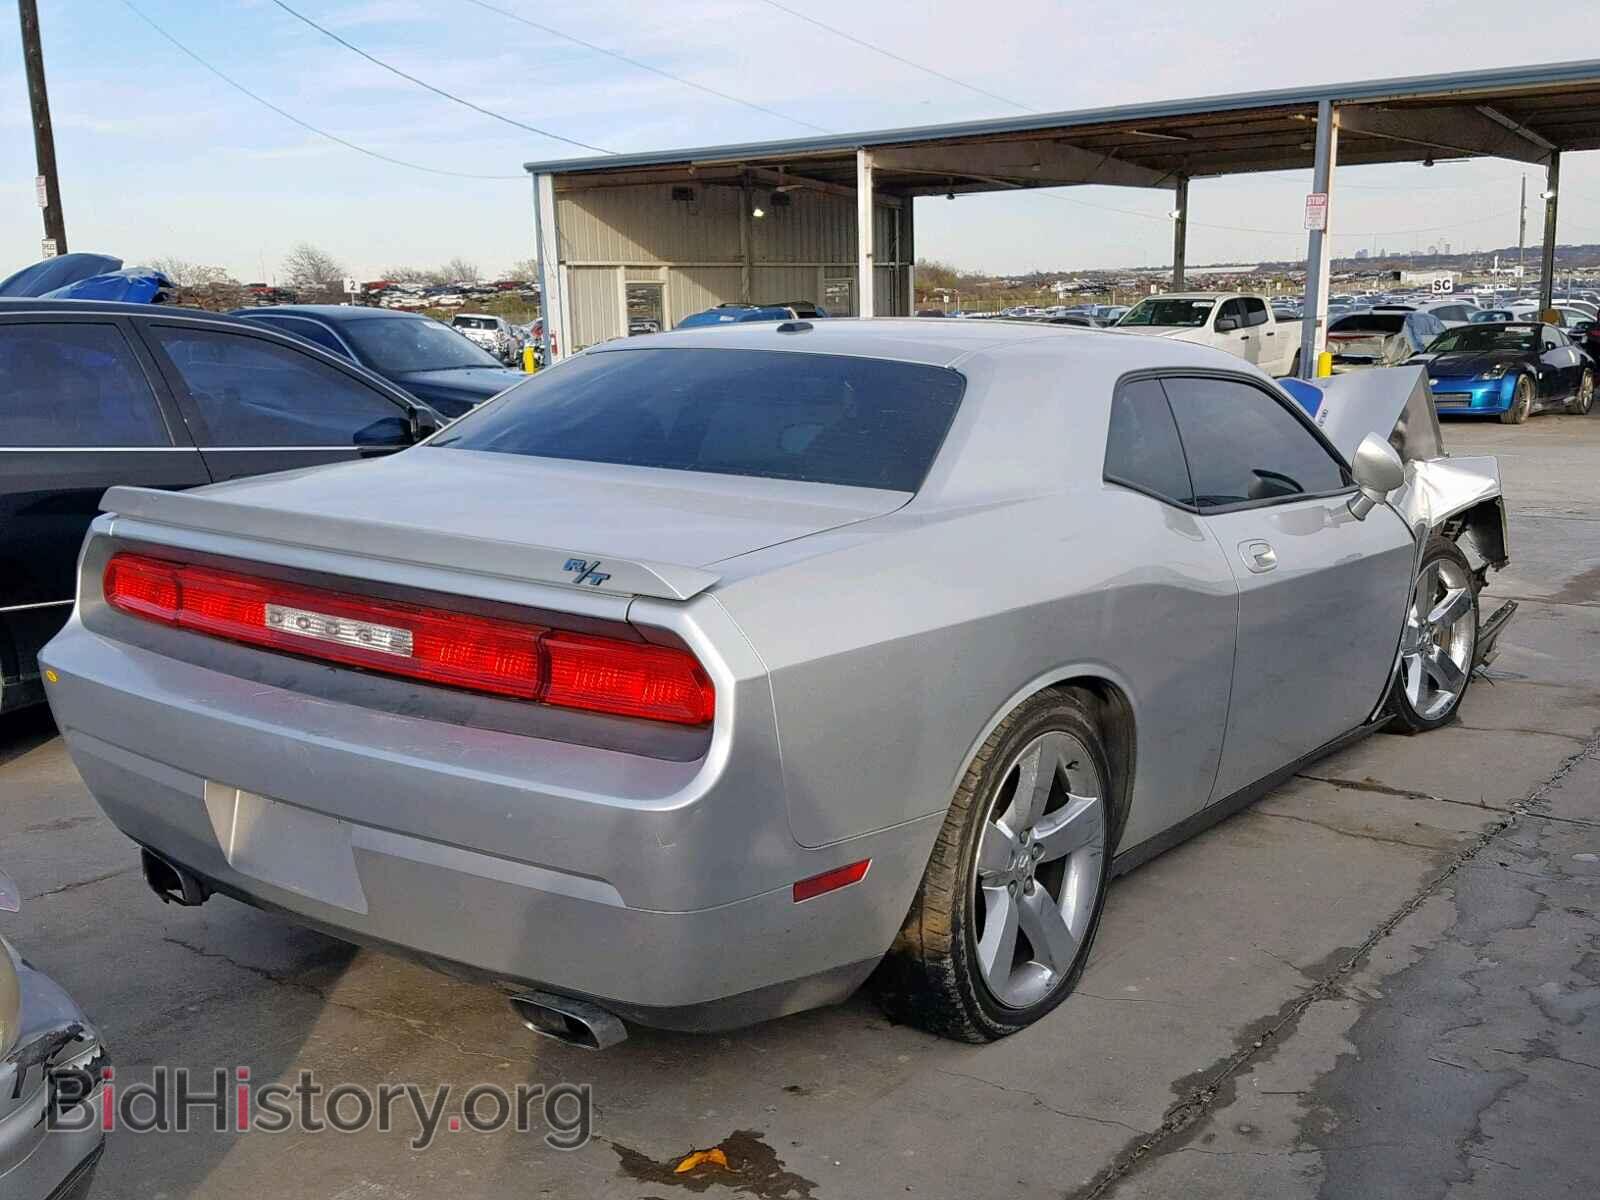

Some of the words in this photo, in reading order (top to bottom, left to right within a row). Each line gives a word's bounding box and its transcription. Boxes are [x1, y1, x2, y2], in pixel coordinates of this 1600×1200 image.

[350, 280, 356, 290] 2
[1433, 280, 1451, 291] SC
[562, 558, 611, 586] R/T
